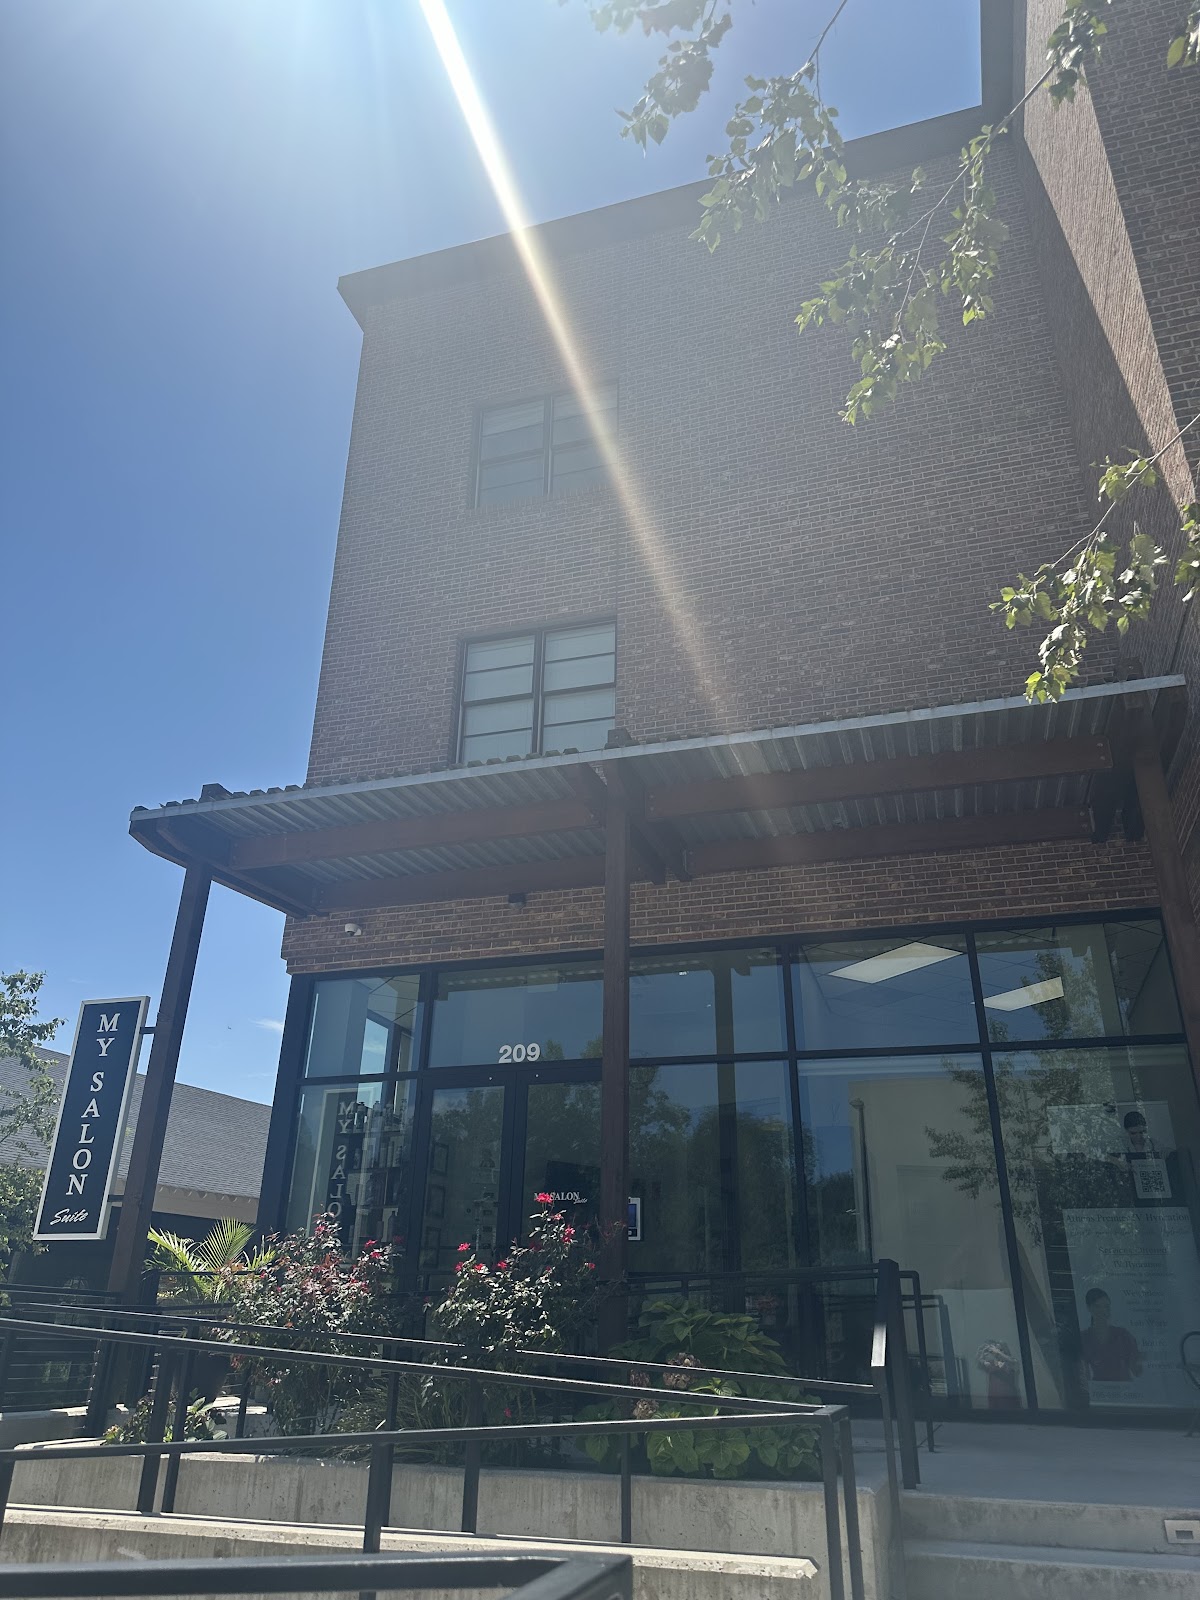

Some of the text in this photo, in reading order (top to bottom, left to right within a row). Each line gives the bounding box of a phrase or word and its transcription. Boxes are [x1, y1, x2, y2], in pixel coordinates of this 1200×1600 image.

[499, 1042, 541, 1064] 209
[65, 1012, 120, 1196] MY SALON
[50, 1208, 89, 1225] Suite
